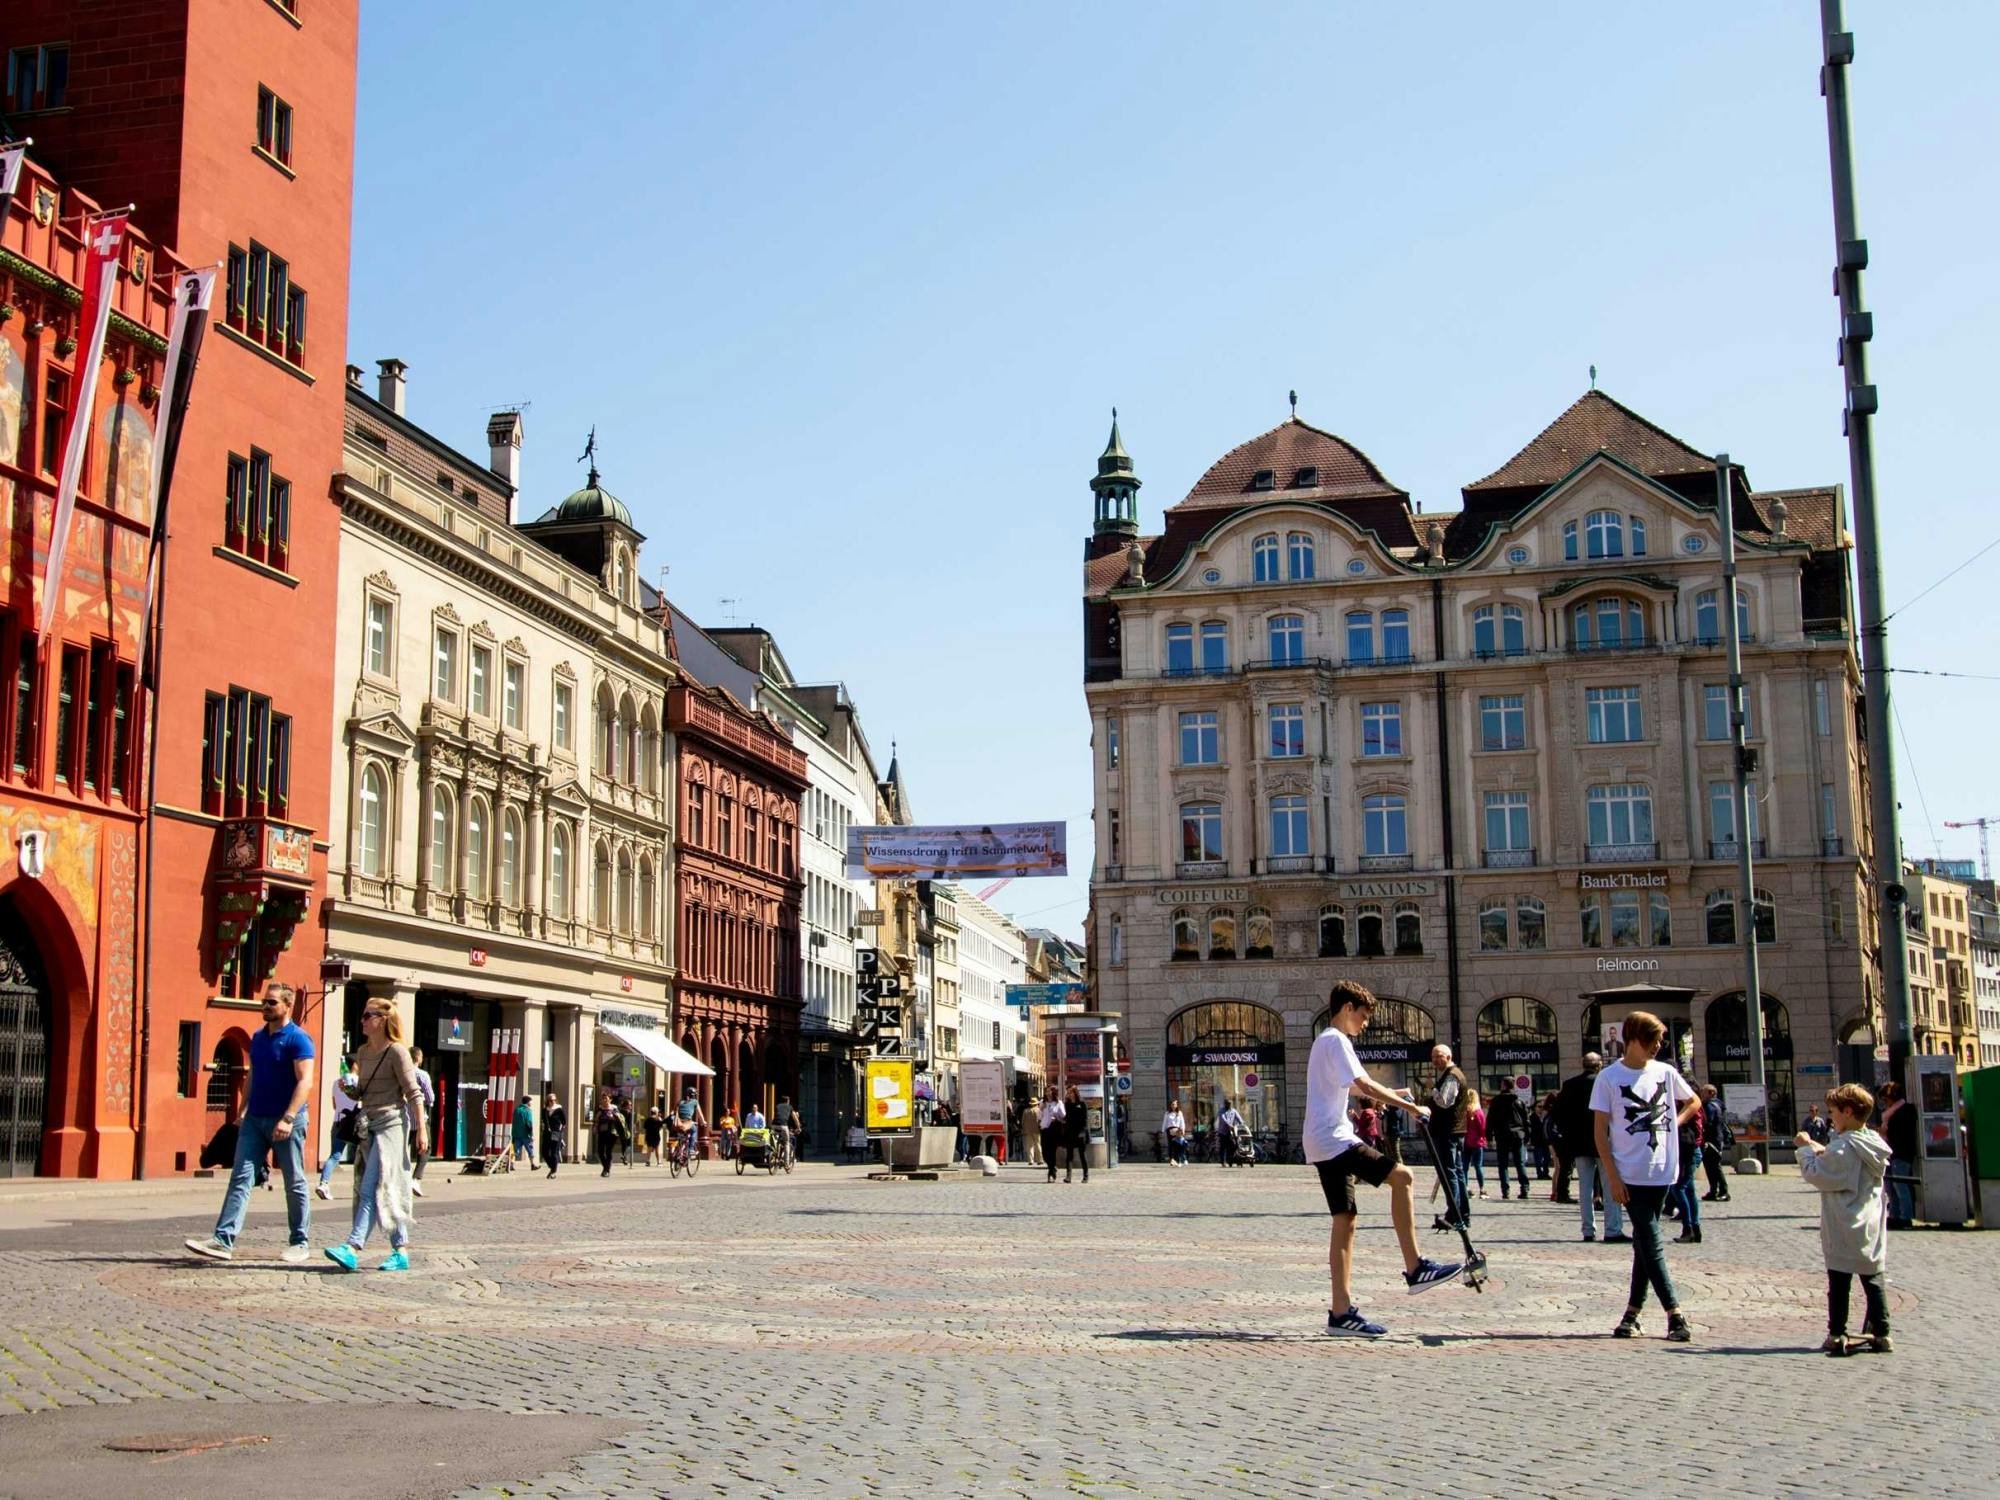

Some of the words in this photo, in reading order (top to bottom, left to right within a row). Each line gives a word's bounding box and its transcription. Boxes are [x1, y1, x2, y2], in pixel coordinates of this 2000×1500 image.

[864, 846, 948, 858] Wissensdrang
[951, 846, 978, 856] trifft
[982, 843, 1048, 856] Sammelwut
[1160, 888, 1245, 903] COIFFURE
[1348, 881, 1427, 897] MAXIM'S
[861, 912, 882, 923] WE
[472, 950, 486, 962] CIC
[880, 978, 898, 1055] PKZ
[811, 1043, 829, 1052] WE
[1204, 1052, 1258, 1063] SWAROVSKI
